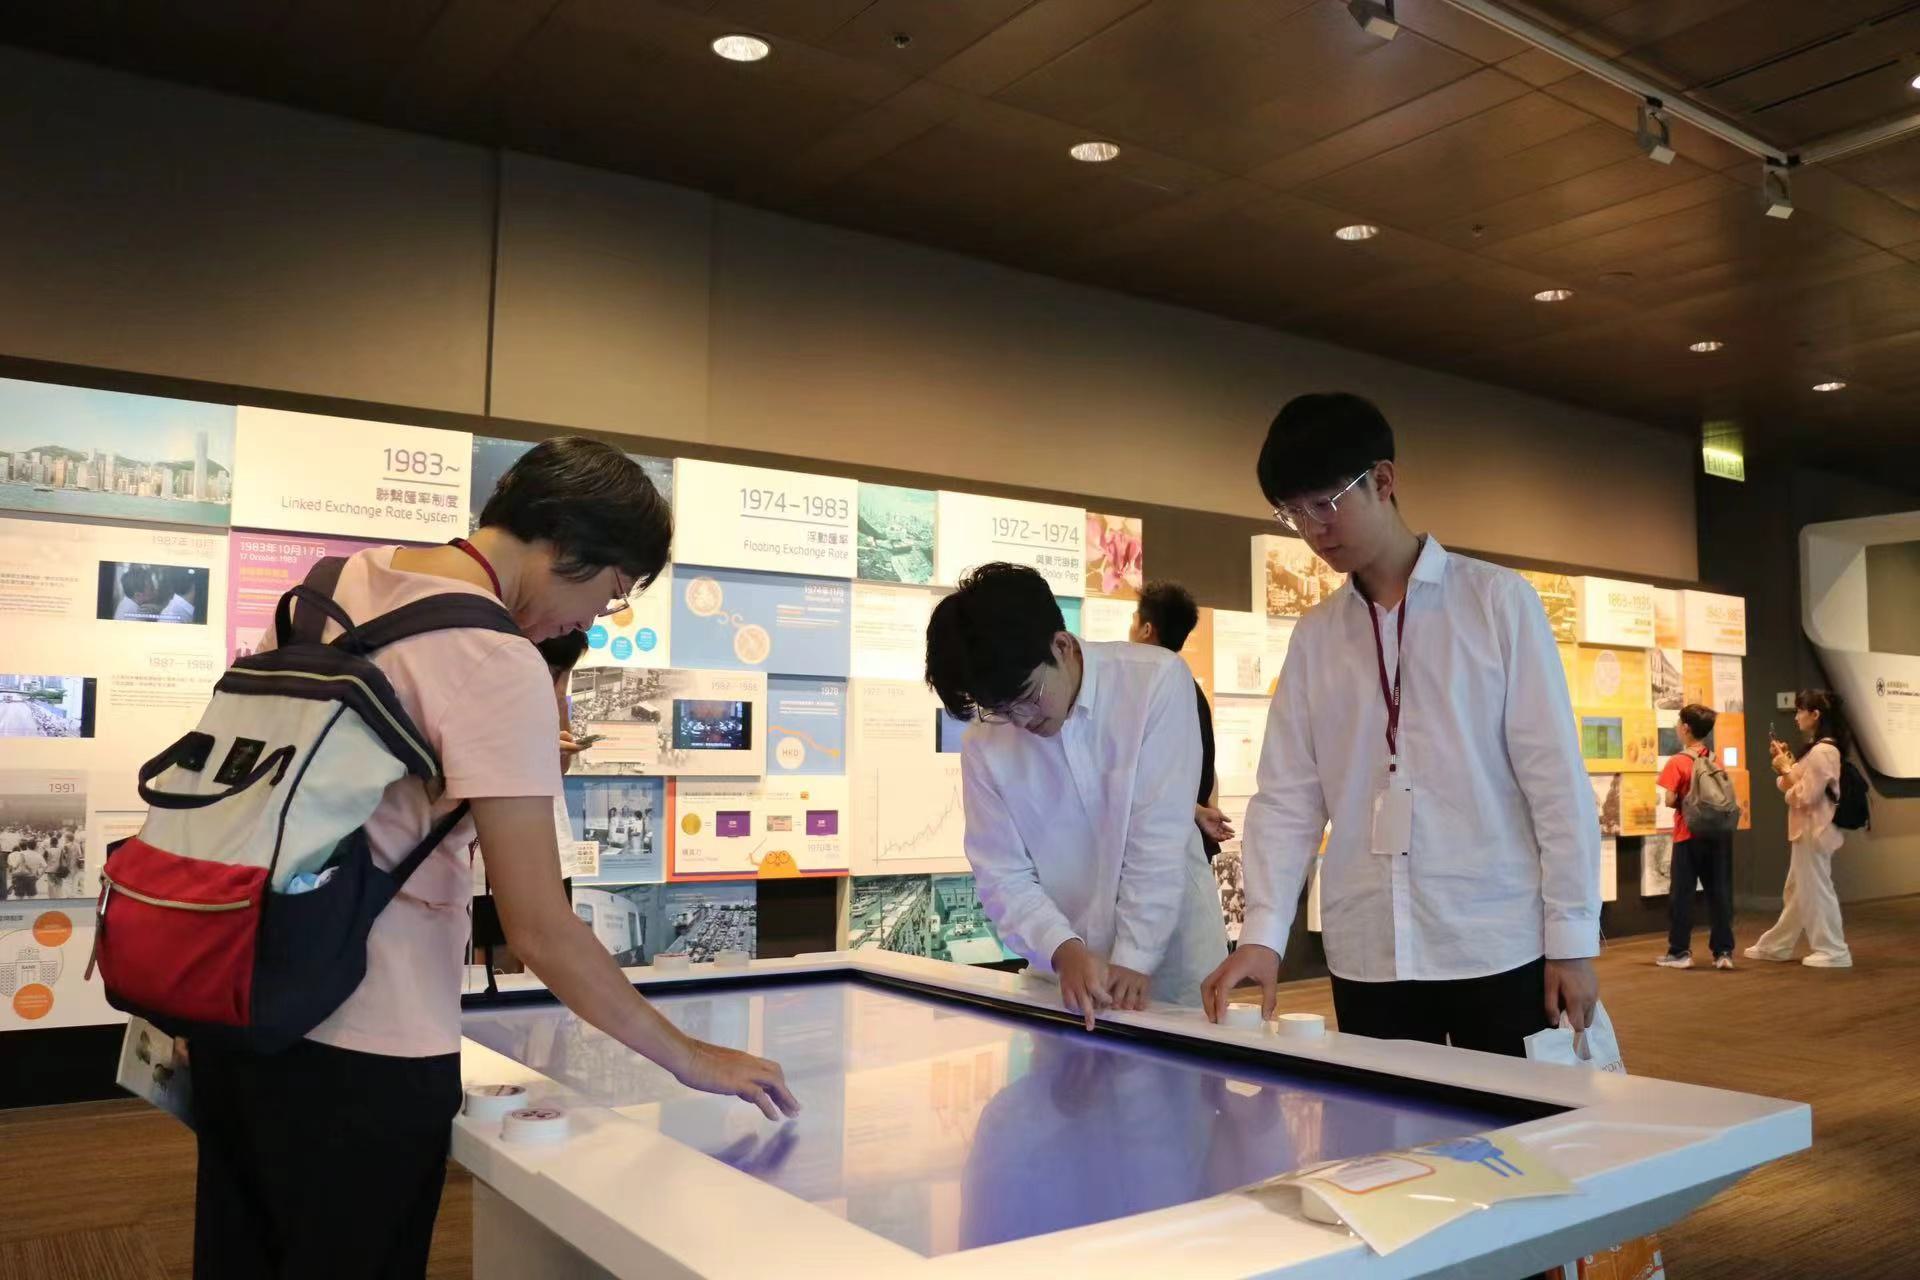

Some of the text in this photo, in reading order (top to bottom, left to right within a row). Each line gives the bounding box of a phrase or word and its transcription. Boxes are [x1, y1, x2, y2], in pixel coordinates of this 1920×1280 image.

[383, 447, 460, 476] 1983~
[376, 487, 459, 509] 聯繫匯率制度
[281, 495, 458, 524] Linked Exchange Rate System
[743, 538, 849, 560] Floating Exchange Rate
[48, 783, 75, 793] 1991
